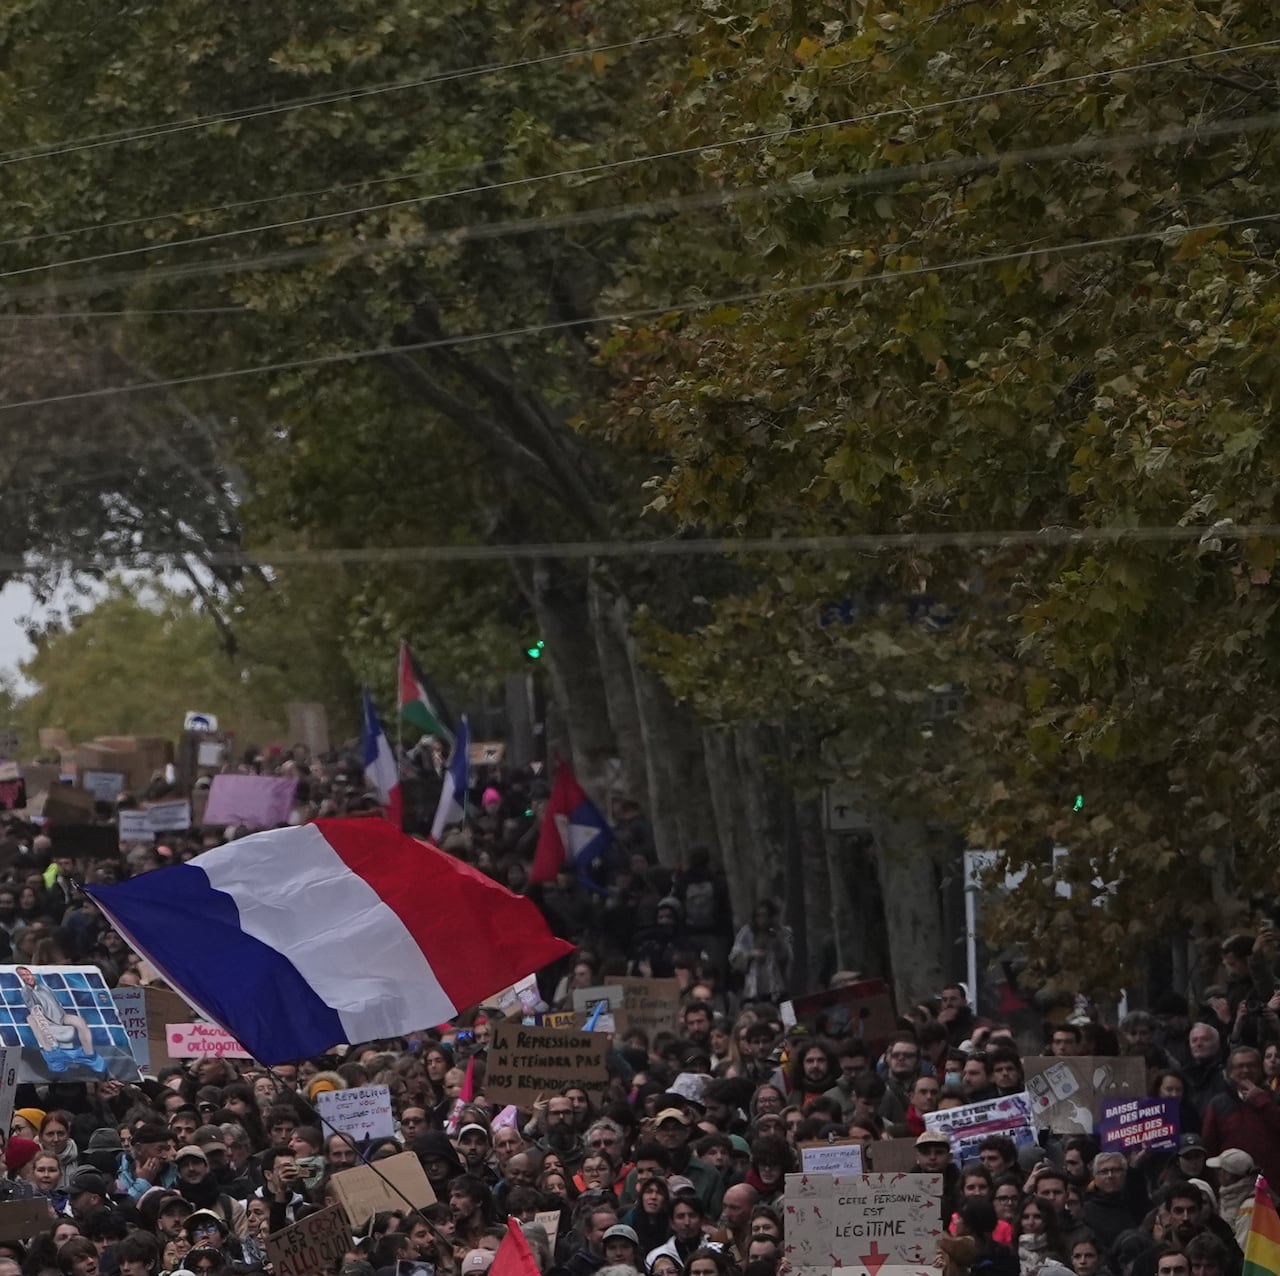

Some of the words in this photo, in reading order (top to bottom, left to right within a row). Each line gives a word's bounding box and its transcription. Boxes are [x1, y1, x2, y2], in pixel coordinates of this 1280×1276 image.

[188, 1025, 232, 1037] Macro
[492, 1033, 508, 1051] LA
[577, 1055, 601, 1067] PAS
[1105, 1101, 1139, 1118] BAISSE
[1120, 1112, 1139, 1125] DES
[1139, 1106, 1162, 1119] PRIX
[1107, 1126, 1144, 1142] HAUSSE
[1145, 1119, 1163, 1131] DES
[1124, 1129, 1169, 1148] SALAIRES
[837, 1194, 868, 1207] CETTE
[873, 1192, 922, 1206] PERSONNE
[864, 1206, 884, 1218] EST
